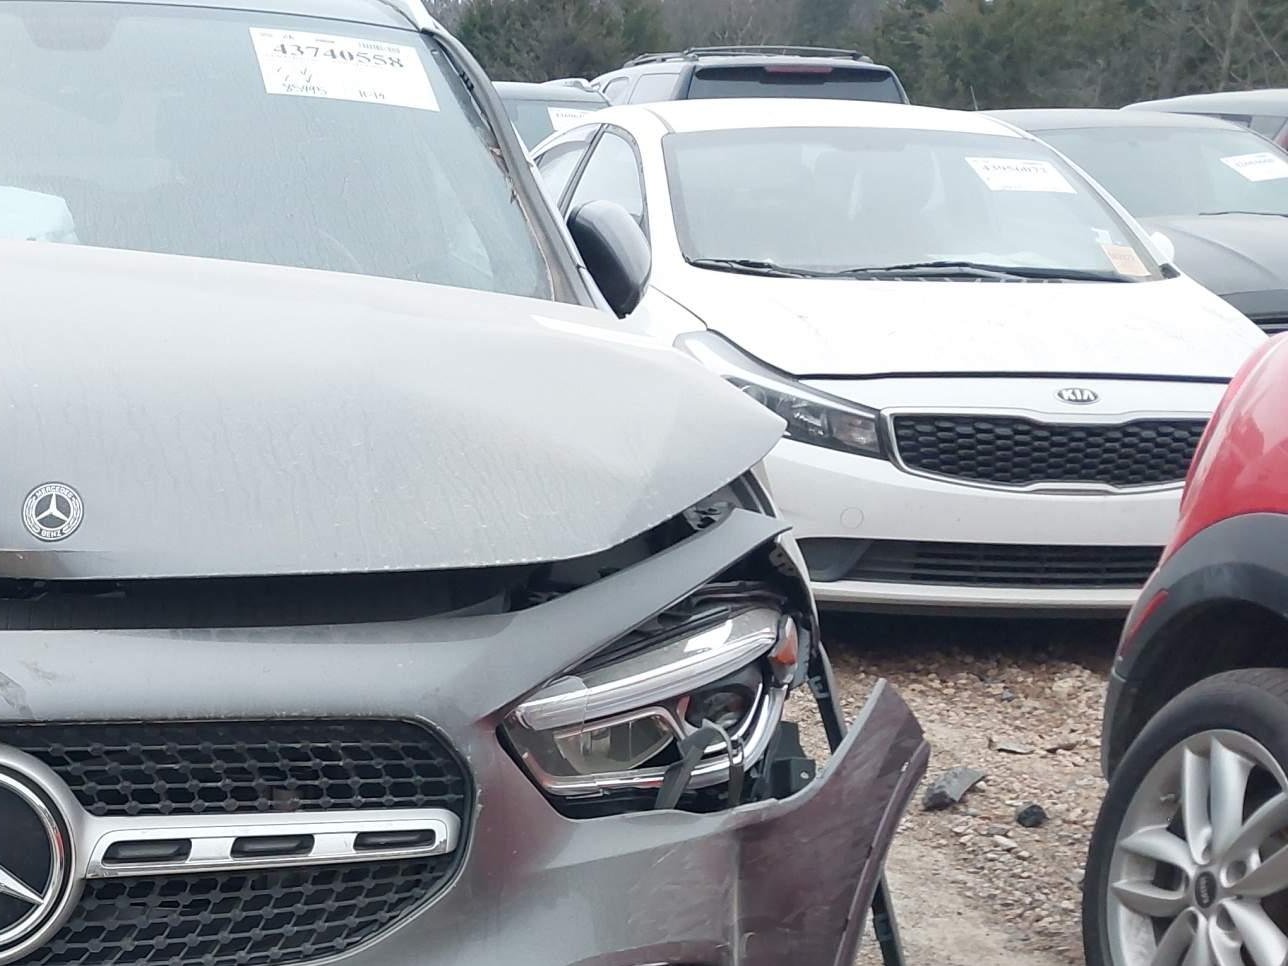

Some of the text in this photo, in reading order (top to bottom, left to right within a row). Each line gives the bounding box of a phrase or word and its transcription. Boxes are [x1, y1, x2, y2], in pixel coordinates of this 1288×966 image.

[273, 43, 404, 68] 43740558
[1060, 388, 1096, 401] KIA
[36, 486, 73, 499] MERCEDES
[41, 529, 62, 538] BENZ
